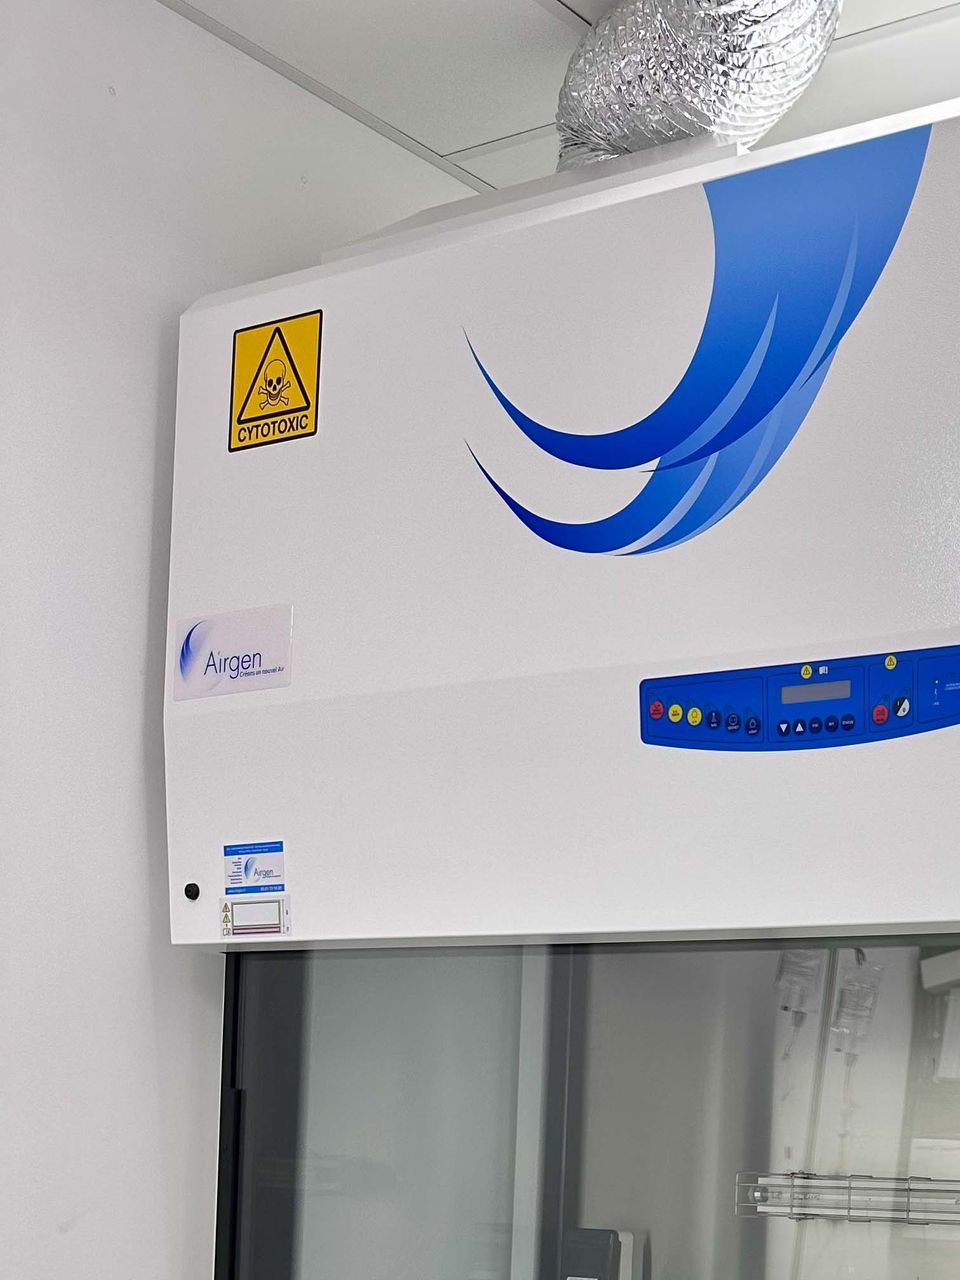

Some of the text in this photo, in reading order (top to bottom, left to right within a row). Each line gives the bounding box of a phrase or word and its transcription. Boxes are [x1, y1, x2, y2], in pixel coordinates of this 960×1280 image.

[238, 414, 309, 442] CYTOTOXIC
[204, 651, 262, 680] Airgen
[254, 868, 274, 878] Airgen
